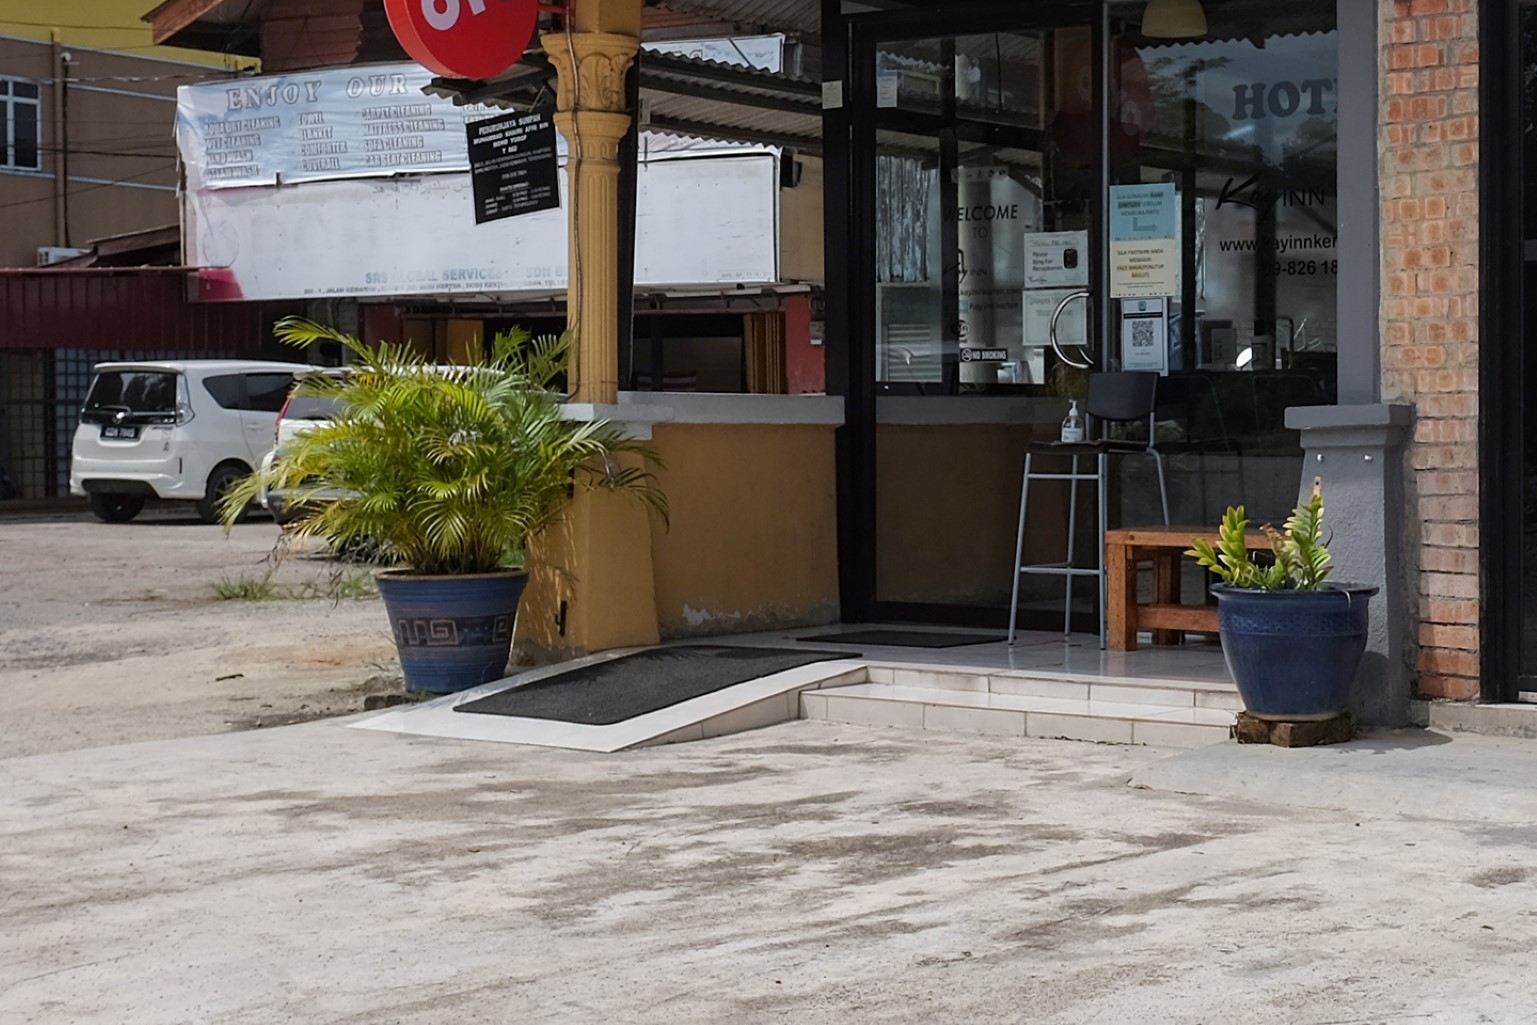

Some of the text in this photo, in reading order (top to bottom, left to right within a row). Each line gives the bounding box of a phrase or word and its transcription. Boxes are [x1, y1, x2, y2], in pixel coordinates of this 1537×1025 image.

[226, 73, 408, 111] ENJOY OUR
[1231, 78, 1337, 121] HOT
[390, 103, 432, 118] CLEANING
[404, 118, 445, 133] CLEANING
[384, 135, 424, 150] CLEANING
[401, 150, 443, 165] CLEANING
[1283, 188, 1325, 207] INN
[943, 204, 1018, 222] WELCOME
[973, 226, 989, 239] TO
[1219, 233, 1337, 253] wwwayinnker
[365, 272, 388, 284] SRS
[972, 350, 1006, 360] NO SMOKING
